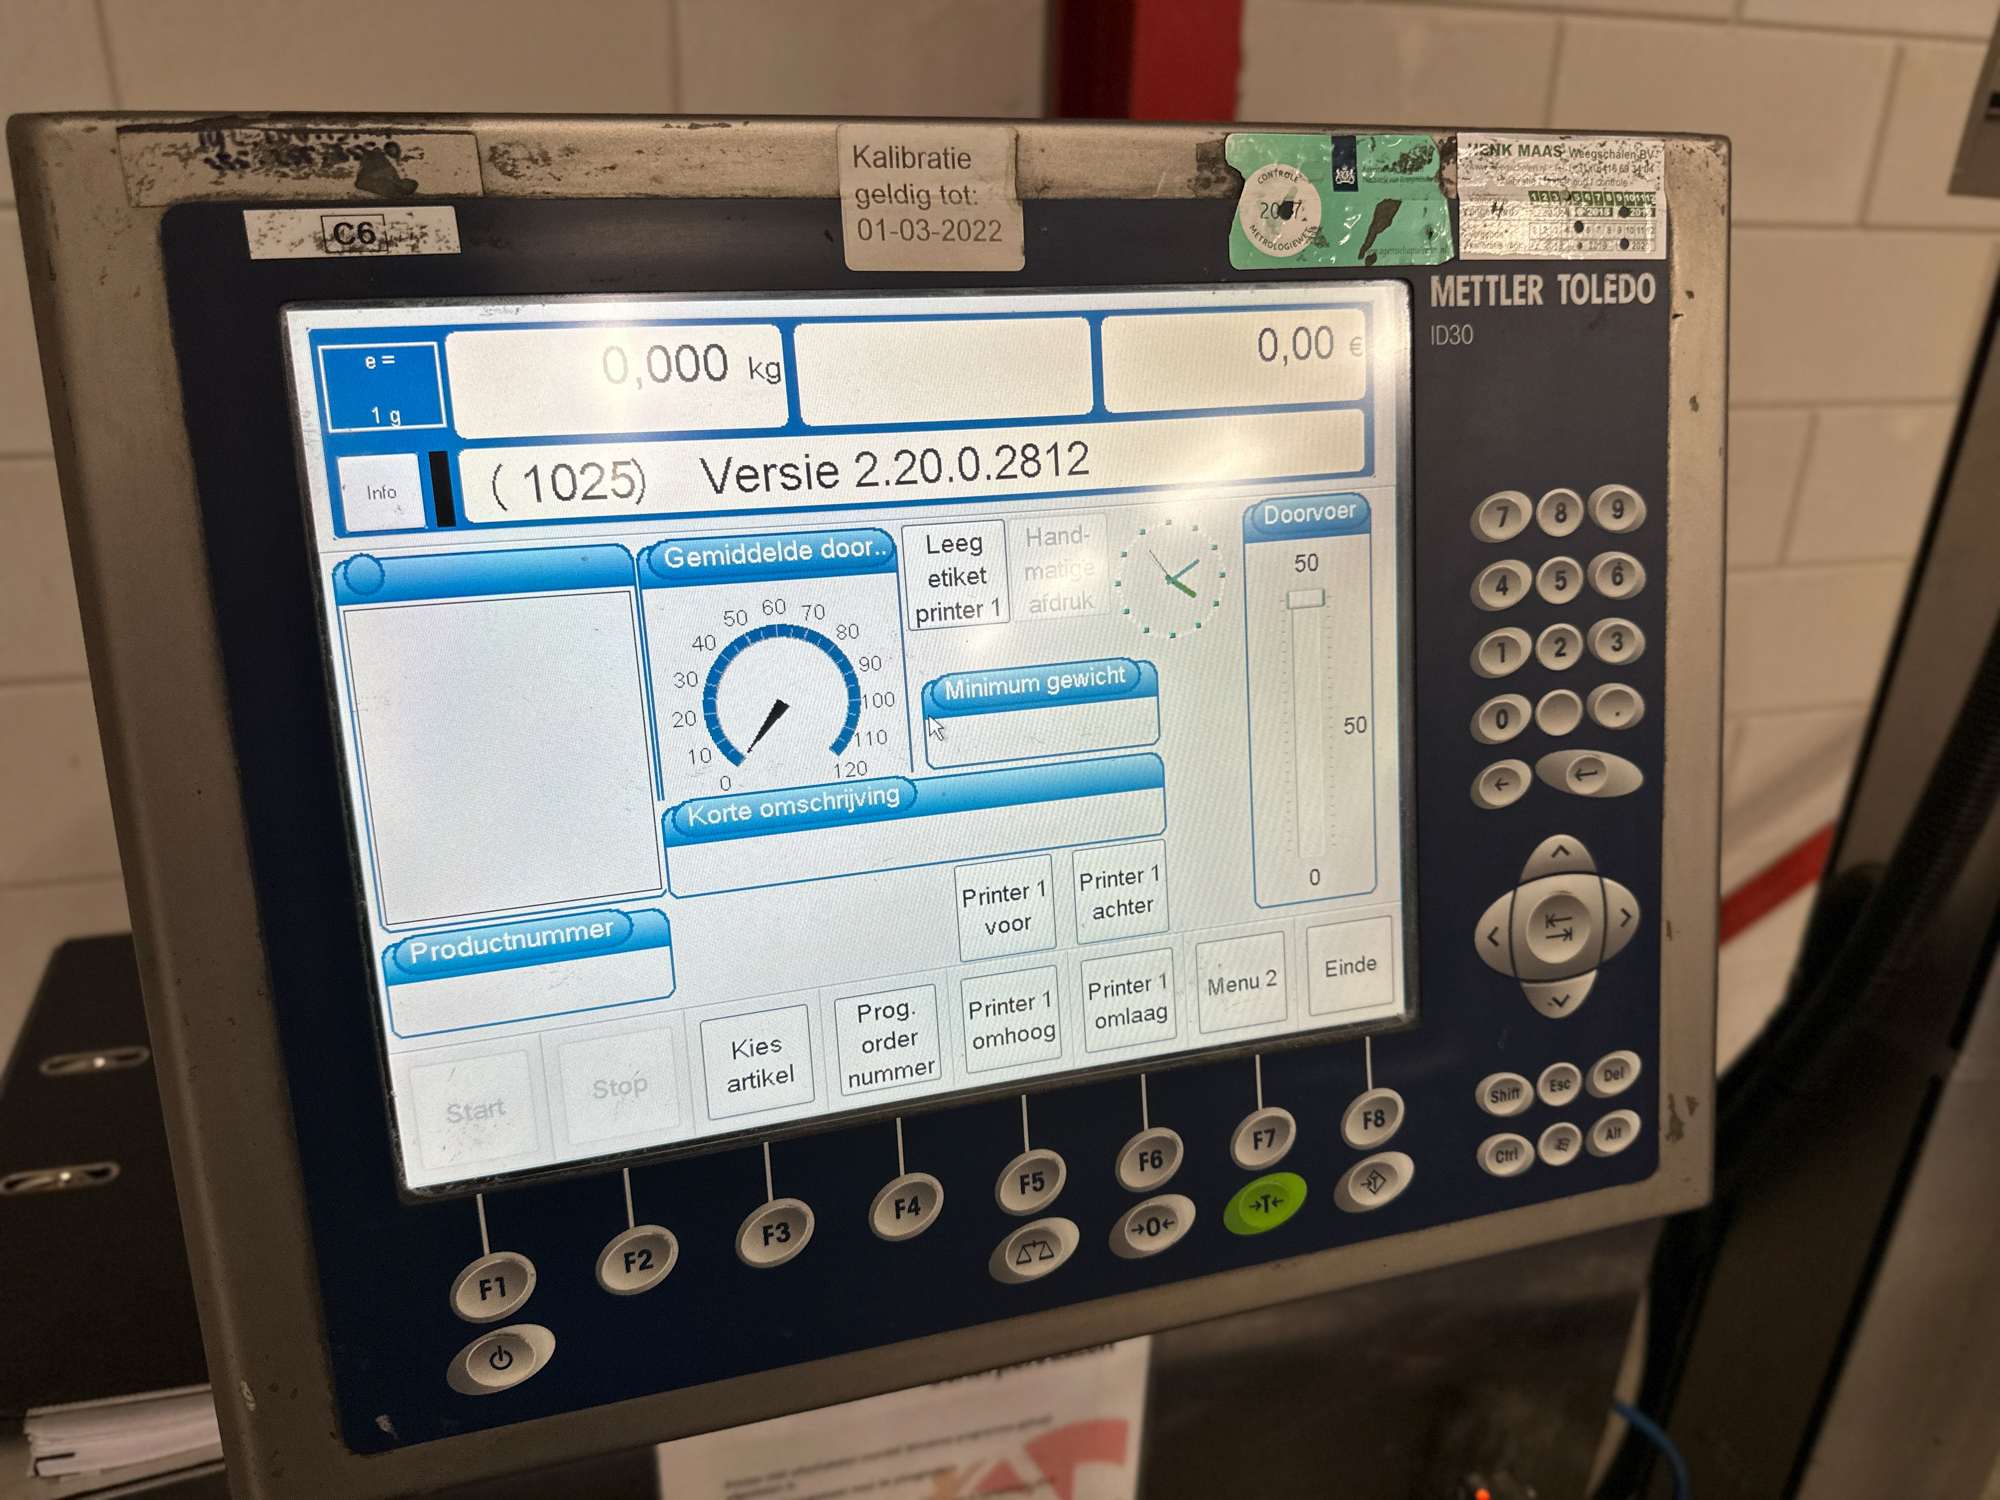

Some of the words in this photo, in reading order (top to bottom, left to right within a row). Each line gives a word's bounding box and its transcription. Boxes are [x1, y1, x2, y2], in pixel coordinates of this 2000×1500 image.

[853, 144, 972, 170] Kalibratie
[1569, 147, 1636, 161] Weegschalen
[1640, 150, 1654, 160] BV
[1257, 168, 1300, 184] CONTROLE
[855, 183, 931, 211] geldig
[940, 185, 978, 206] tot:
[1531, 193, 1537, 201] 1
[1541, 193, 1549, 201] 2
[1552, 193, 1559, 201] 3
[1573, 193, 1580, 202] 5
[1584, 193, 1591, 202] 6
[1595, 193, 1601, 202] 7
[1605, 193, 1612, 202] 8
[1616, 193, 1622, 202] 9
[1624, 193, 1635, 202] 10
[1635, 193, 1645, 202] 11
[1645, 193, 1656, 202] 12
[1260, 200, 1303, 219] 207
[333, 221, 377, 246] C6
[857, 217, 1002, 242] 01-03-2022
[1249, 225, 1312, 251] METROLOGIEWET
[1430, 274, 1544, 308] METTLER
[1557, 272, 1657, 305] TOLEDO
[1431, 323, 1474, 346] ID30
[1258, 325, 1334, 367] 0,00
[1350, 336, 1363, 357] €
[365, 356, 376, 369] e
[602, 343, 729, 390] 0,000
[748, 356, 782, 385] kg
[371, 406, 380, 424] 1
[390, 410, 401, 427] g
[700, 453, 840, 495] Versie
[855, 440, 1090, 488] 2.20.0.2812
[367, 485, 398, 501] Info
[1264, 502, 1357, 526] Doorvoer
[1496, 505, 1509, 528] 7
[1555, 501, 1568, 523] 8
[1612, 498, 1624, 520] 9
[926, 534, 983, 556] Leeg
[1026, 525, 1090, 547] Hand-
[664, 540, 813, 569] Gemiddelde
[821, 537, 887, 563] door..
[1294, 552, 1319, 573] 50
[928, 566, 987, 588] etiket
[1025, 558, 1095, 582] matige
[1554, 570, 1567, 591] 5
[1611, 567, 1624, 586] 6
[1495, 574, 1509, 596] 4
[762, 599, 786, 615] 60
[801, 604, 826, 621] 70
[915, 603, 984, 628] printer
[991, 598, 1000, 618] 1
[1029, 591, 1095, 614] afdruk
[723, 610, 748, 627] 50
[836, 623, 860, 640] 80
[1611, 631, 1624, 652] 3
[692, 634, 716, 652] 40
[1497, 642, 1506, 663] 1
[1554, 637, 1567, 657] 2
[859, 655, 882, 672] 90
[673, 671, 698, 688] 30
[945, 676, 1041, 700] Minimum
[1048, 666, 1126, 695] gewicht
[862, 691, 895, 709] 100
[672, 710, 697, 728] 20
[1343, 715, 1368, 735] 50
[1495, 709, 1508, 730] 0
[854, 729, 888, 748] 110
[688, 748, 712, 765] 10
[834, 760, 868, 779] 120
[720, 775, 731, 791] 0
[688, 801, 753, 829] Korte
[759, 785, 901, 819] omschrijving
[1079, 867, 1145, 892] Printer
[1150, 863, 1160, 882] 1
[1310, 868, 1321, 886] 0
[962, 883, 1033, 908] Printer
[1037, 879, 1046, 898] 1
[1092, 896, 1154, 920] achter
[985, 915, 1032, 936] voor
[410, 918, 615, 964] Productnummer
[1325, 955, 1377, 978] Einde
[1088, 975, 1153, 1000] Printer
[1159, 972, 1168, 990] 1
[1208, 973, 1260, 996] Menu
[1266, 969, 1277, 987] 2
[857, 1002, 916, 1024] Prog.
[969, 995, 1036, 1020] Printer
[1043, 990, 1051, 1008] 1
[1095, 1004, 1168, 1030] omlaag
[731, 1034, 783, 1059] Kies
[862, 1030, 919, 1054] order
[972, 1023, 1056, 1050] omhoog
[726, 1064, 795, 1093] artikel
[849, 1059, 936, 1088] nummer
[1604, 1066, 1624, 1082] Del
[592, 1074, 649, 1100] Stop
[1490, 1086, 1520, 1104] Shift
[1550, 1078, 1571, 1093] Esc
[446, 1098, 507, 1124] Start
[1362, 1109, 1386, 1131] F8
[1252, 1128, 1276, 1151] F7
[1605, 1126, 1622, 1141] Alt
[1138, 1148, 1164, 1172] F6
[1495, 1146, 1519, 1164] Ctrl
[1019, 1170, 1045, 1196] F5
[893, 1195, 922, 1221] F4
[761, 1221, 791, 1247] F3
[623, 1247, 654, 1274] F2
[478, 1276, 507, 1302] F1
